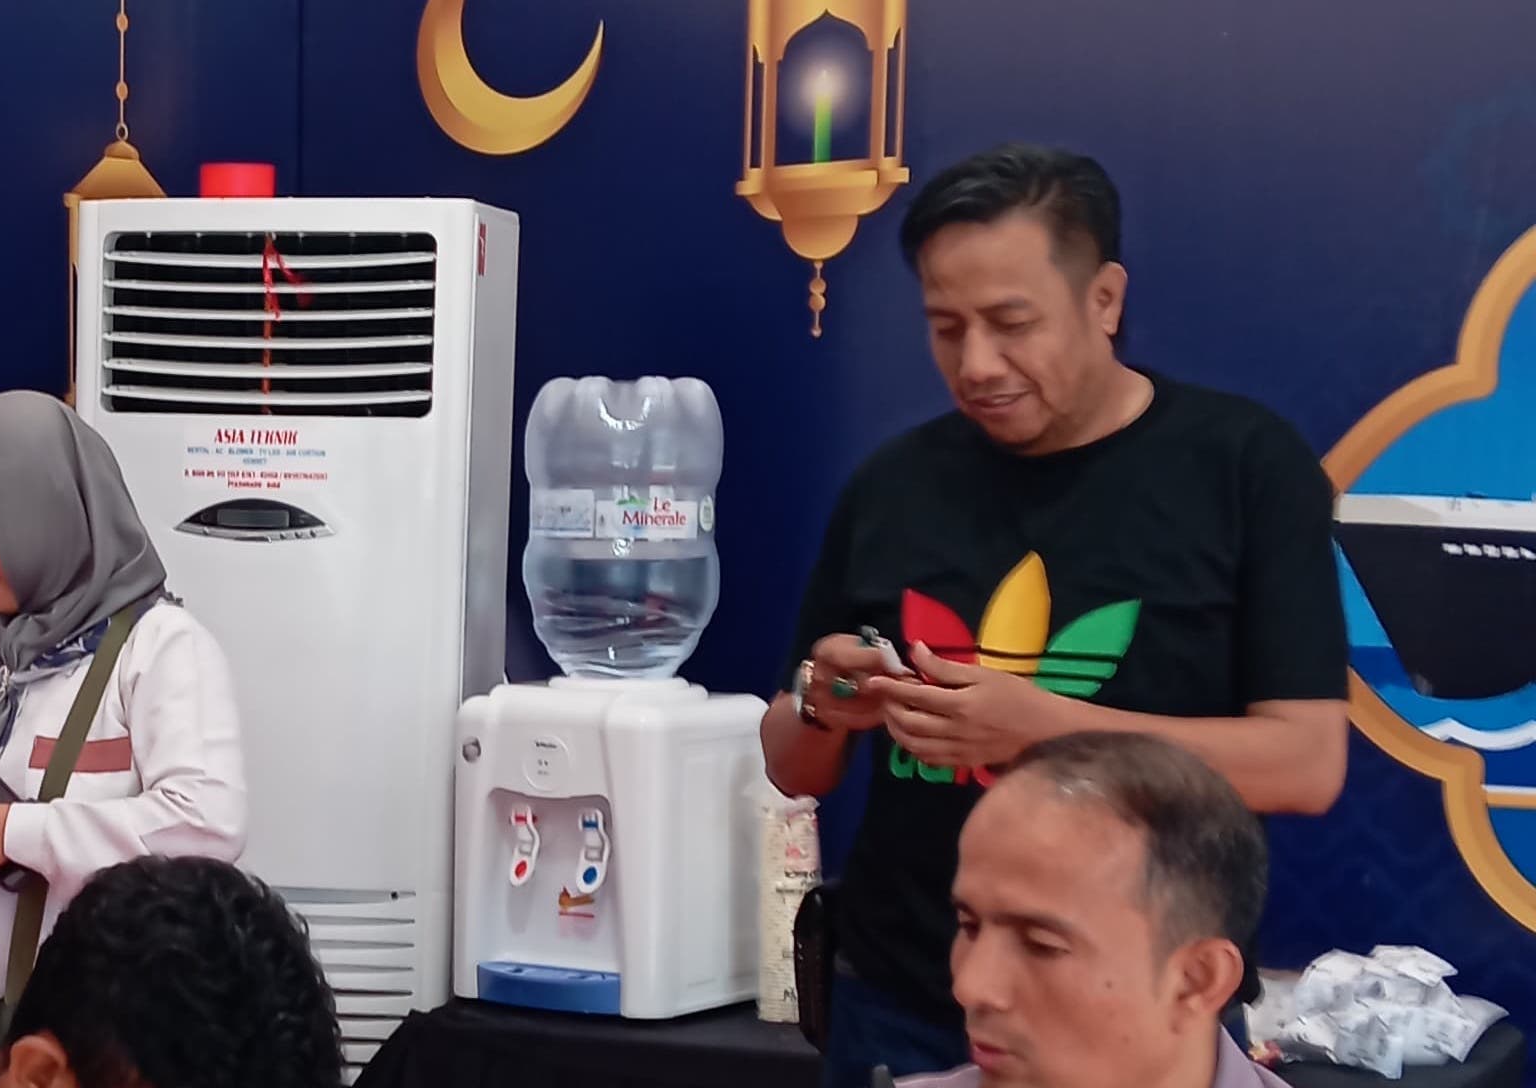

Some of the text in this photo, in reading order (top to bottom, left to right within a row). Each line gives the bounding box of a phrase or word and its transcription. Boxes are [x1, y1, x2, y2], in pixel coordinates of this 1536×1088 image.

[214, 428, 244, 444] ASIA
[653, 496, 671, 512] Le
[622, 510, 687, 527] Minerale
